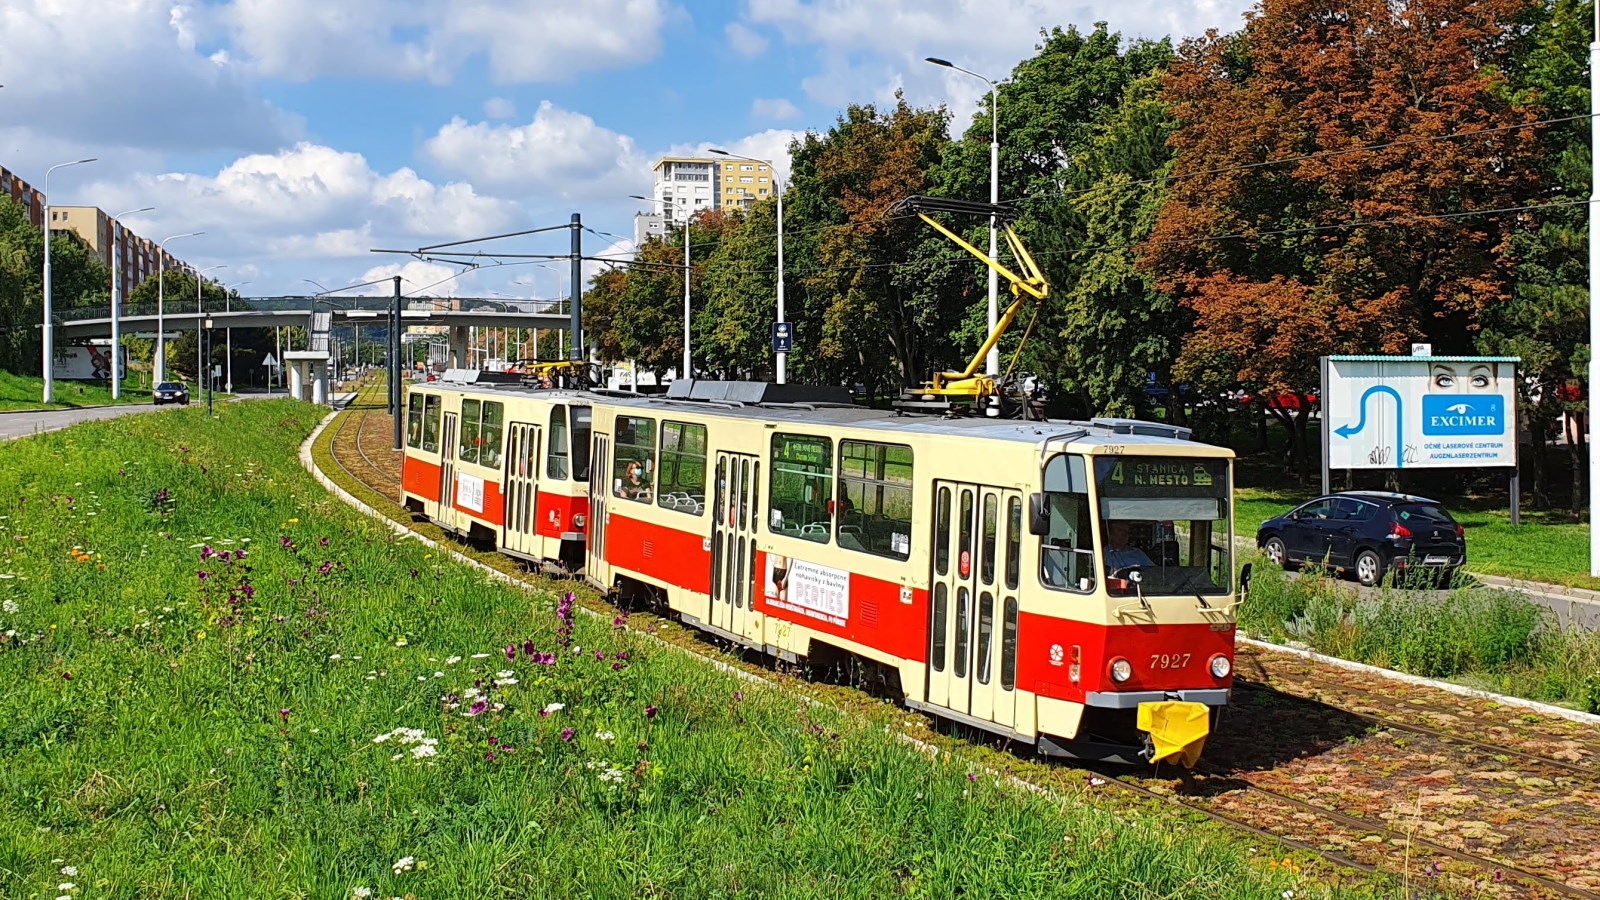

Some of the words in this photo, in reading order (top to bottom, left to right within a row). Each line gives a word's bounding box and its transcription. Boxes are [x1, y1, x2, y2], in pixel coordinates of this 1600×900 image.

[1431, 416, 1496, 427] EXCIMER
[783, 441, 790, 459] 4
[1103, 445, 1125, 454] 7927
[1442, 442, 1474, 450] LASEROVÉ
[1111, 461, 1125, 485] 4
[1136, 463, 1186, 474] STANICA
[1134, 474, 1147, 485] N.
[1149, 474, 1189, 485] MESTO
[1150, 653, 1191, 669] 7927
